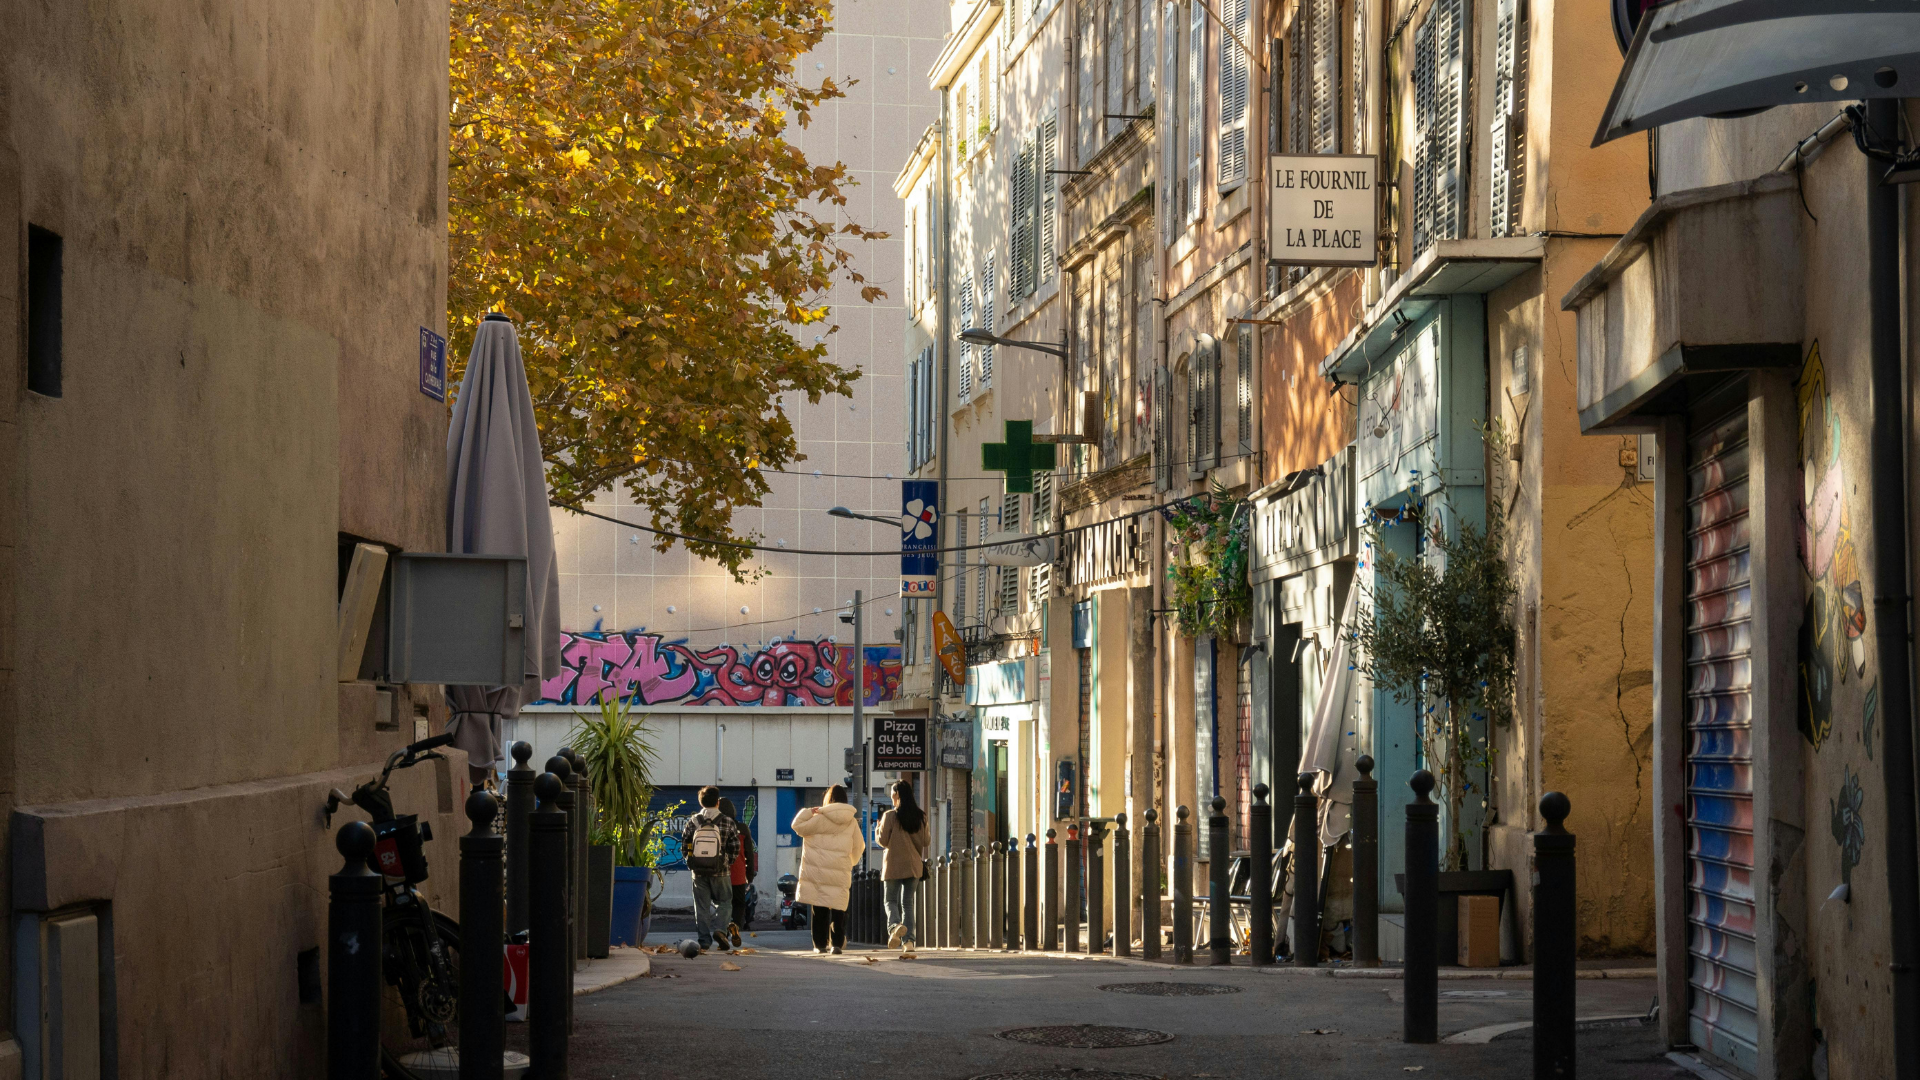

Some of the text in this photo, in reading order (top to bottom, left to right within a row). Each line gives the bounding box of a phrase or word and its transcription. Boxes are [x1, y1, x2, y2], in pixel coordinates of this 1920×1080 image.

[1276, 169, 1371, 190] LE FOURNIL
[1313, 199, 1334, 219] DE
[1286, 228, 1362, 249] LA PLACE
[987, 543, 1019, 557] PMU
[1063, 514, 1139, 588] PHARMACIE
[901, 580, 936, 593] LOTO
[937, 621, 964, 676] TAAC
[883, 720, 916, 732] Pizza
[878, 732, 918, 743] au feu
[877, 743, 922, 755] de bois
